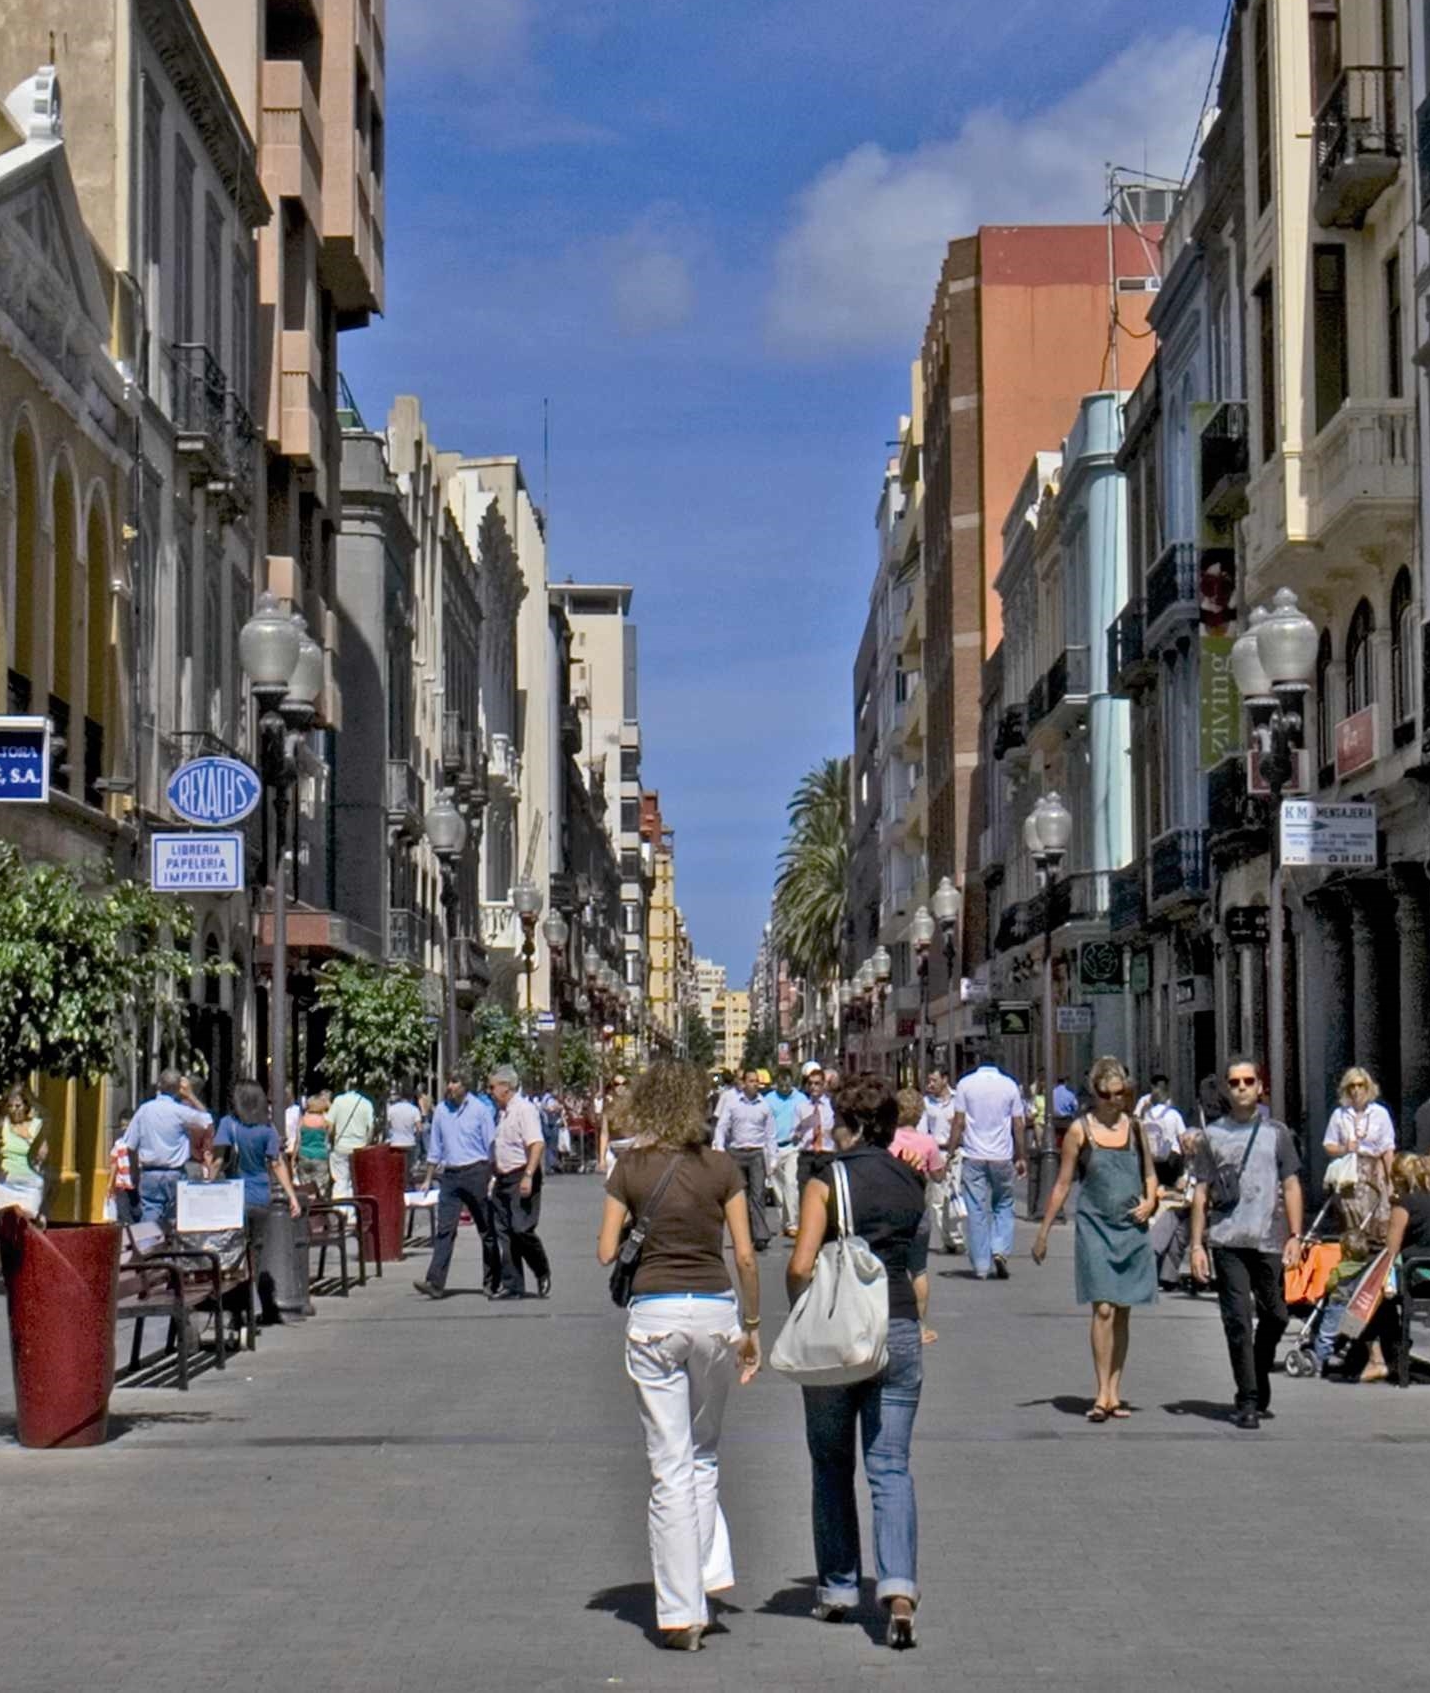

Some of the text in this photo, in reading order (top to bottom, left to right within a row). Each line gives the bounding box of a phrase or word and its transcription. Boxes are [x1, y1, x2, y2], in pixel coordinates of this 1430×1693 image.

[9, 767, 41, 783] S.A.
[171, 844, 221, 855] LIBRERIA
[166, 858, 227, 869] PAPELERIA
[164, 872, 229, 883] IMPRENTA
